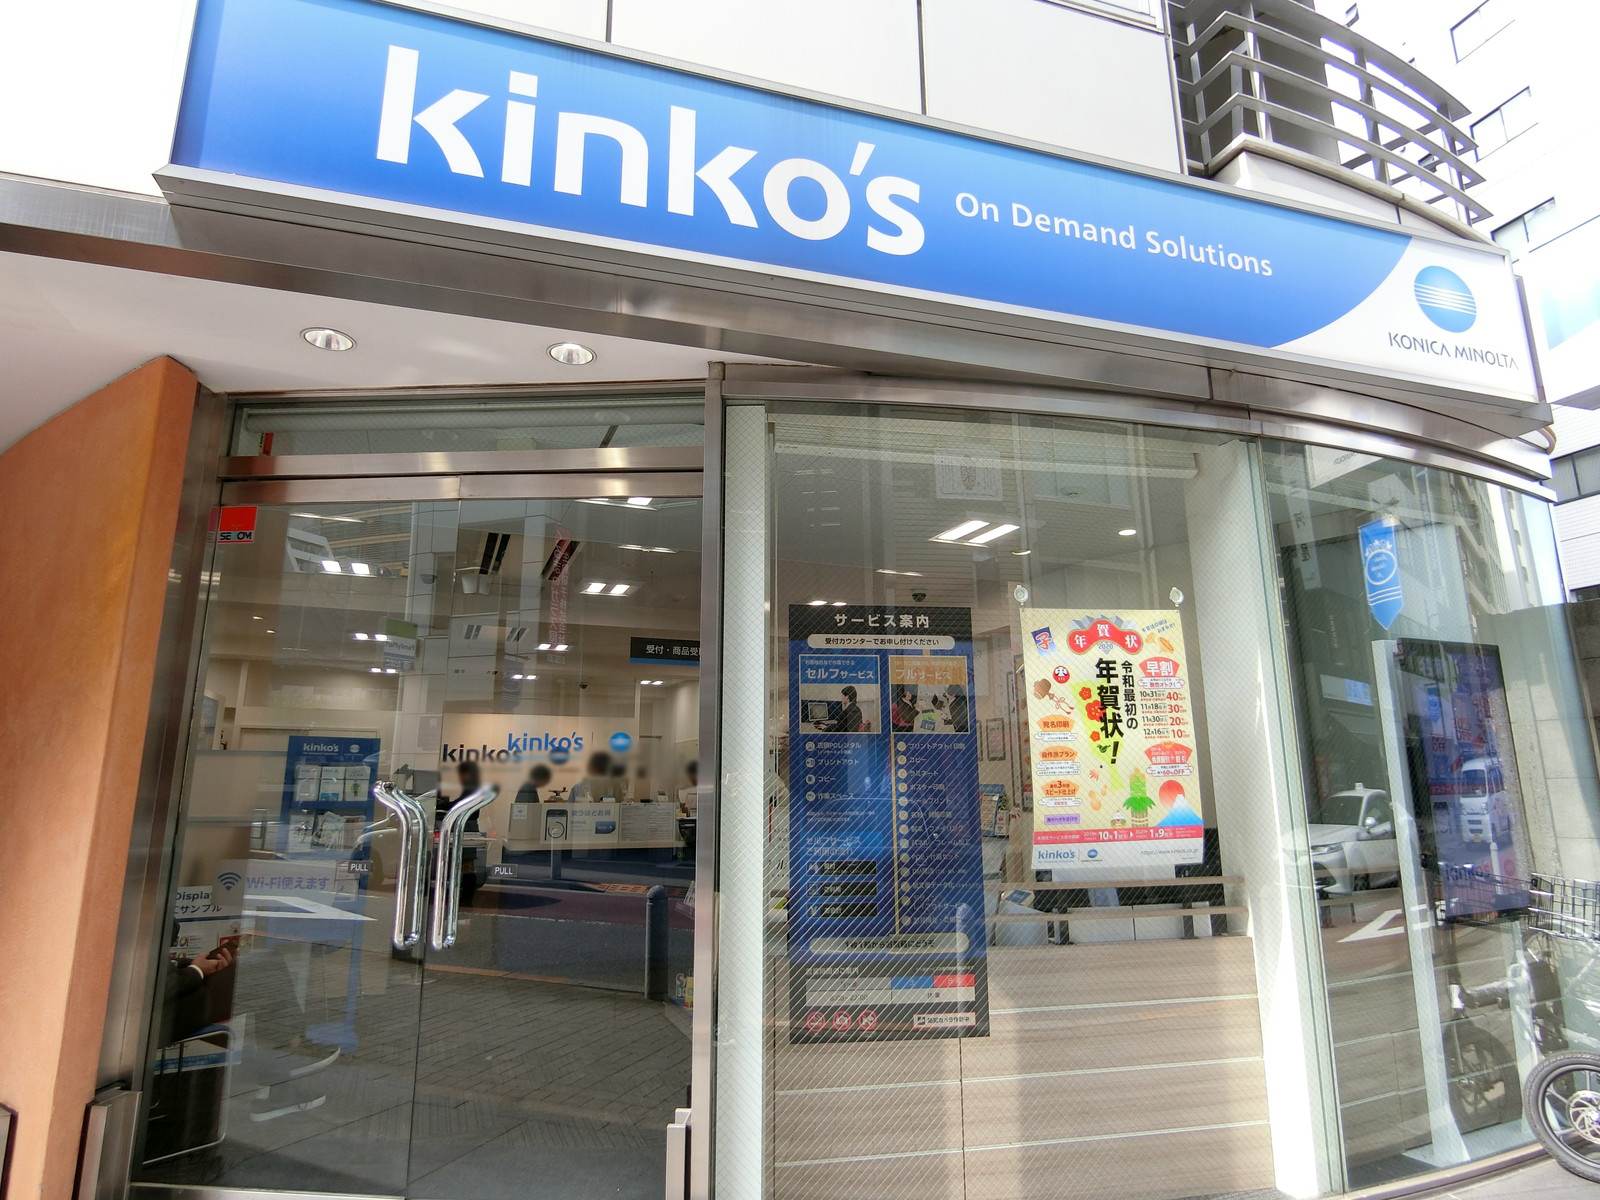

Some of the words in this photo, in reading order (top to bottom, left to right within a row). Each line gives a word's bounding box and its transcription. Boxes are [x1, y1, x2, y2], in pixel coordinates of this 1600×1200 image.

[376, 44, 925, 257] kinko's
[954, 192, 1000, 224] On
[1011, 203, 1136, 252] Demand
[1146, 230, 1273, 278] Solutions
[1388, 331, 1451, 359] KONICA
[1453, 345, 1519, 371] MINOLTA
[220, 531, 253, 541] SEOM
[834, 613, 930, 629] サービス案内
[824, 637, 940, 646] 受付カウンターでお申し付けください
[1073, 623, 1139, 649] 年賀状
[646, 644, 701, 657] 受付・商品受
[805, 668, 875, 680] セルフサービス
[1146, 661, 1174, 676] 早割
[1121, 660, 1139, 730] 令和最初の
[303, 742, 340, 753] kinko's
[1037, 849, 1076, 860] kinko's
[350, 863, 369, 872] PULL
[494, 866, 513, 875] PULL
[246, 876, 330, 890] Wi-Fi使えます
[175, 890, 213, 901] Displa
